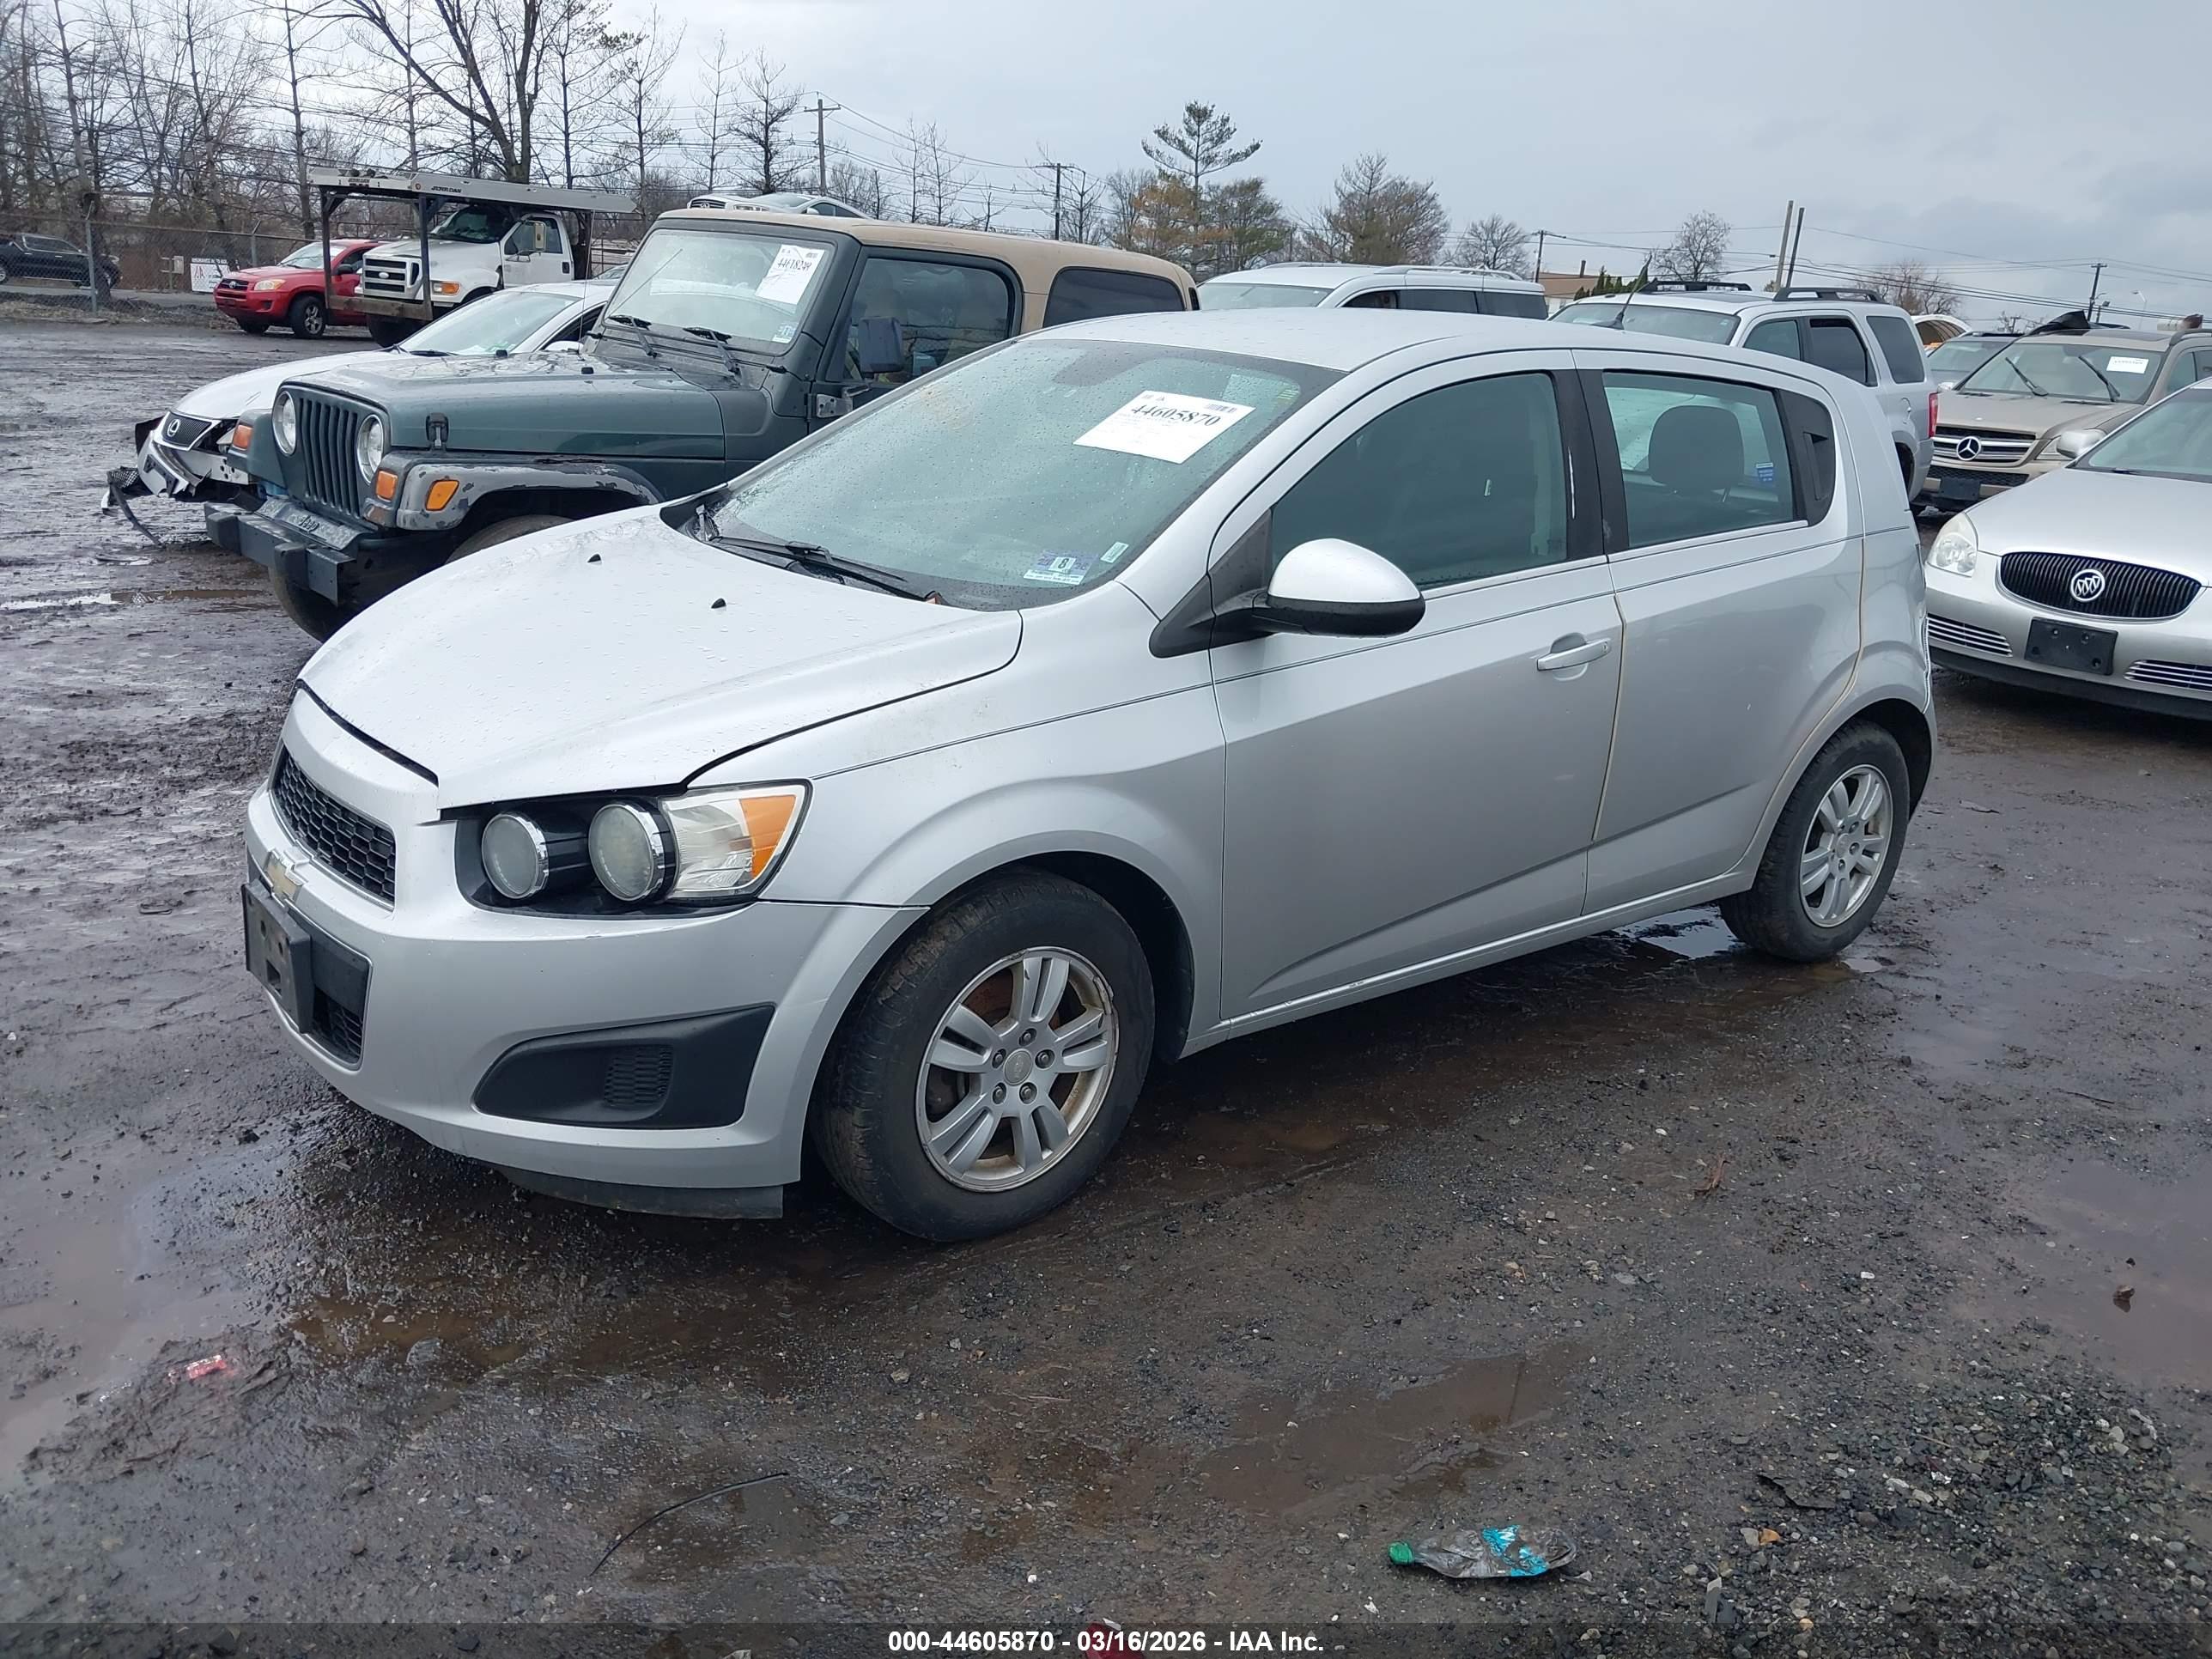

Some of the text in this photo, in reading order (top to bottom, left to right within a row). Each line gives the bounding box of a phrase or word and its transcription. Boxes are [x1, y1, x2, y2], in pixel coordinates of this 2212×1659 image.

[1131, 404, 1221, 427] 44605870
[298, 515, 320, 532] Jeep
[1057, 558, 1070, 569] 8
